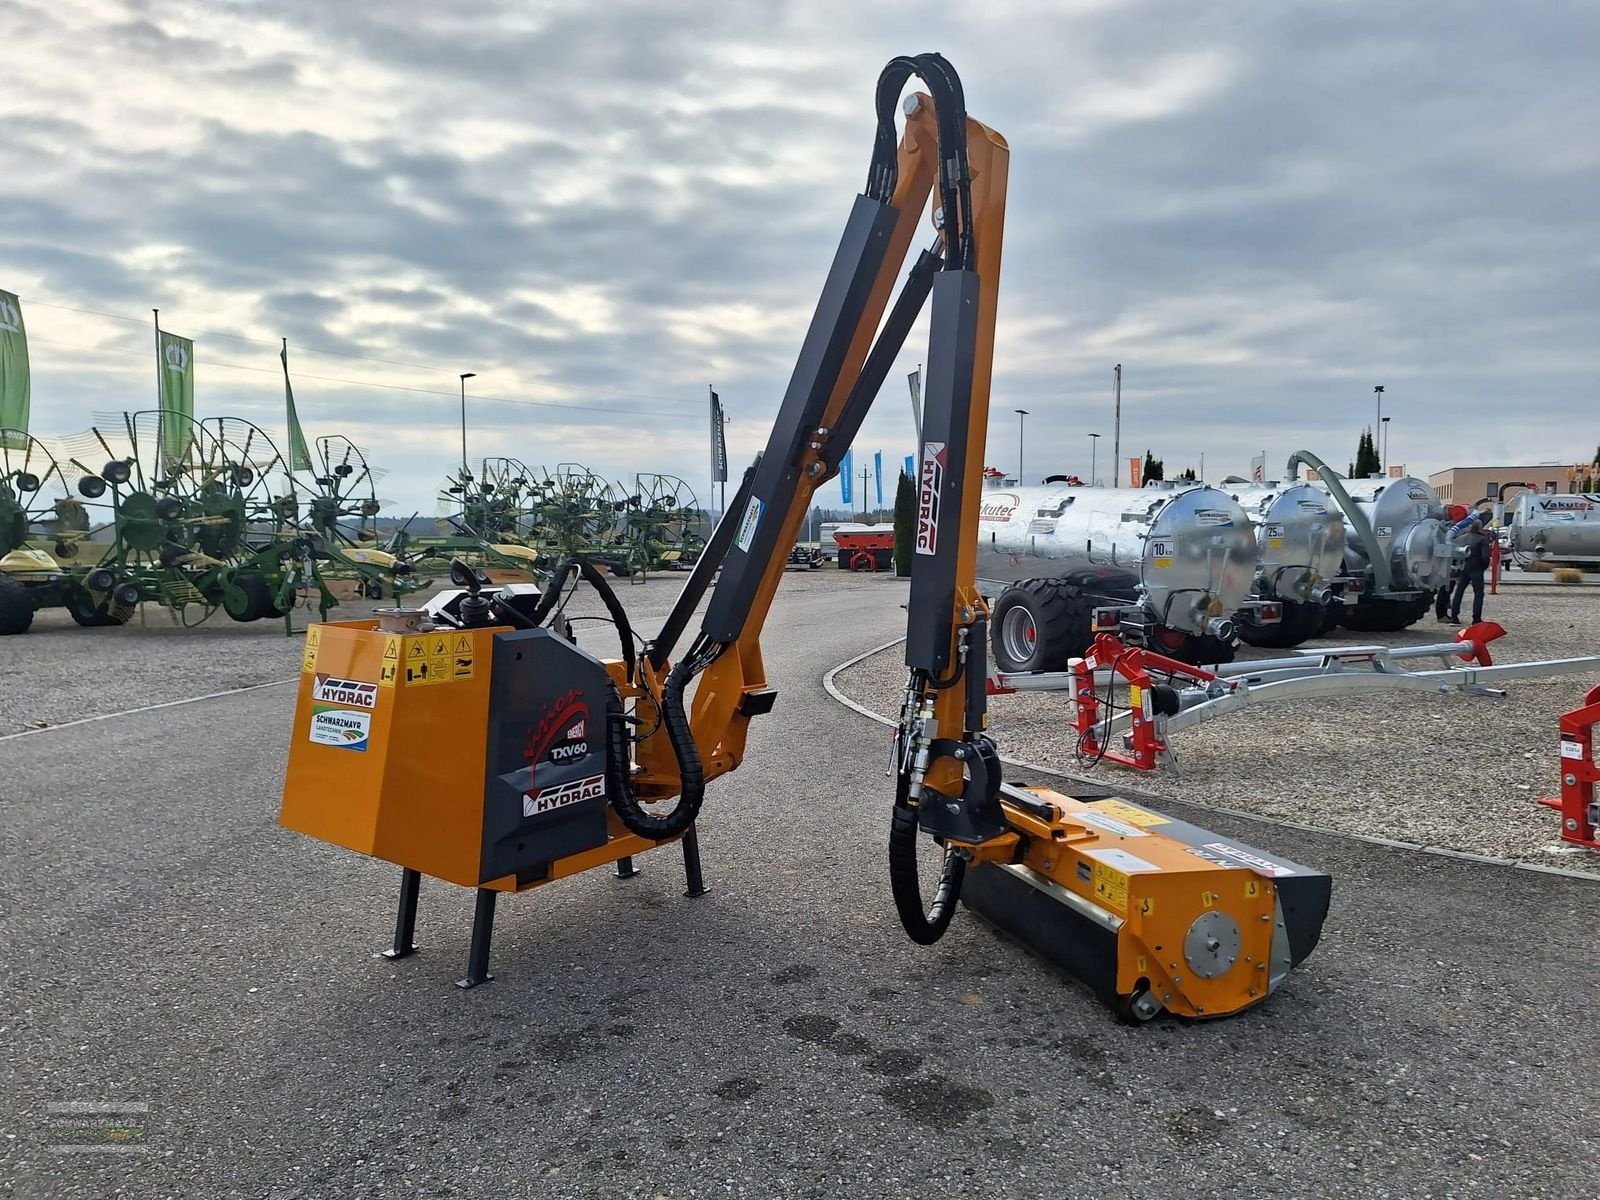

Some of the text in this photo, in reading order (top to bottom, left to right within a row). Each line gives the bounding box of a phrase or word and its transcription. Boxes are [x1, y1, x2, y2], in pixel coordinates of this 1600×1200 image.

[917, 461, 934, 549] HYDRAC
[980, 503, 1016, 517] kutec
[1539, 499, 1594, 510] Vakutec
[1268, 527, 1277, 537] 25
[1378, 527, 1386, 537] 25
[1154, 543, 1165, 556] 10
[322, 688, 373, 706] HYDRAC
[316, 715, 362, 730] SCHWARZMAYR
[567, 719, 585, 739] ENERGY
[551, 742, 588, 760] TXV60
[537, 785, 602, 812] HYDRAC
